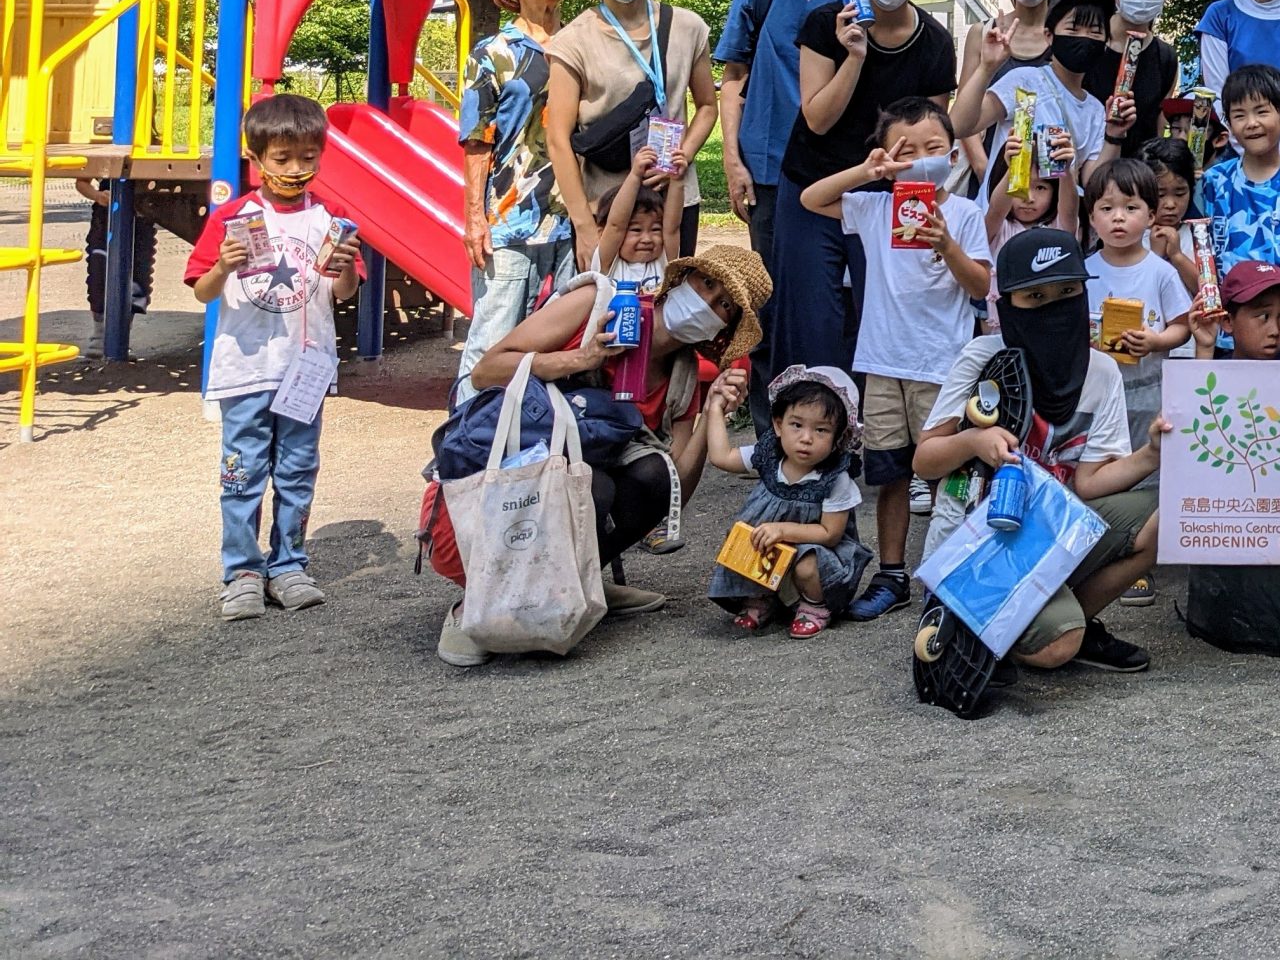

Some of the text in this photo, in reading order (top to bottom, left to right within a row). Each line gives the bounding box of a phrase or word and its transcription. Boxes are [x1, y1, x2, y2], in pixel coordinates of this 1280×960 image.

[901, 206, 926, 222] ビスコ
[1037, 246, 1062, 262] NIKE
[255, 288, 274, 305] ALL
[621, 306, 630, 338] SWEAT
[627, 306, 636, 341] POCARI
[502, 491, 541, 512] snidel
[1179, 521, 1243, 534] Takashima
[1179, 535, 1269, 549] GARDENING
